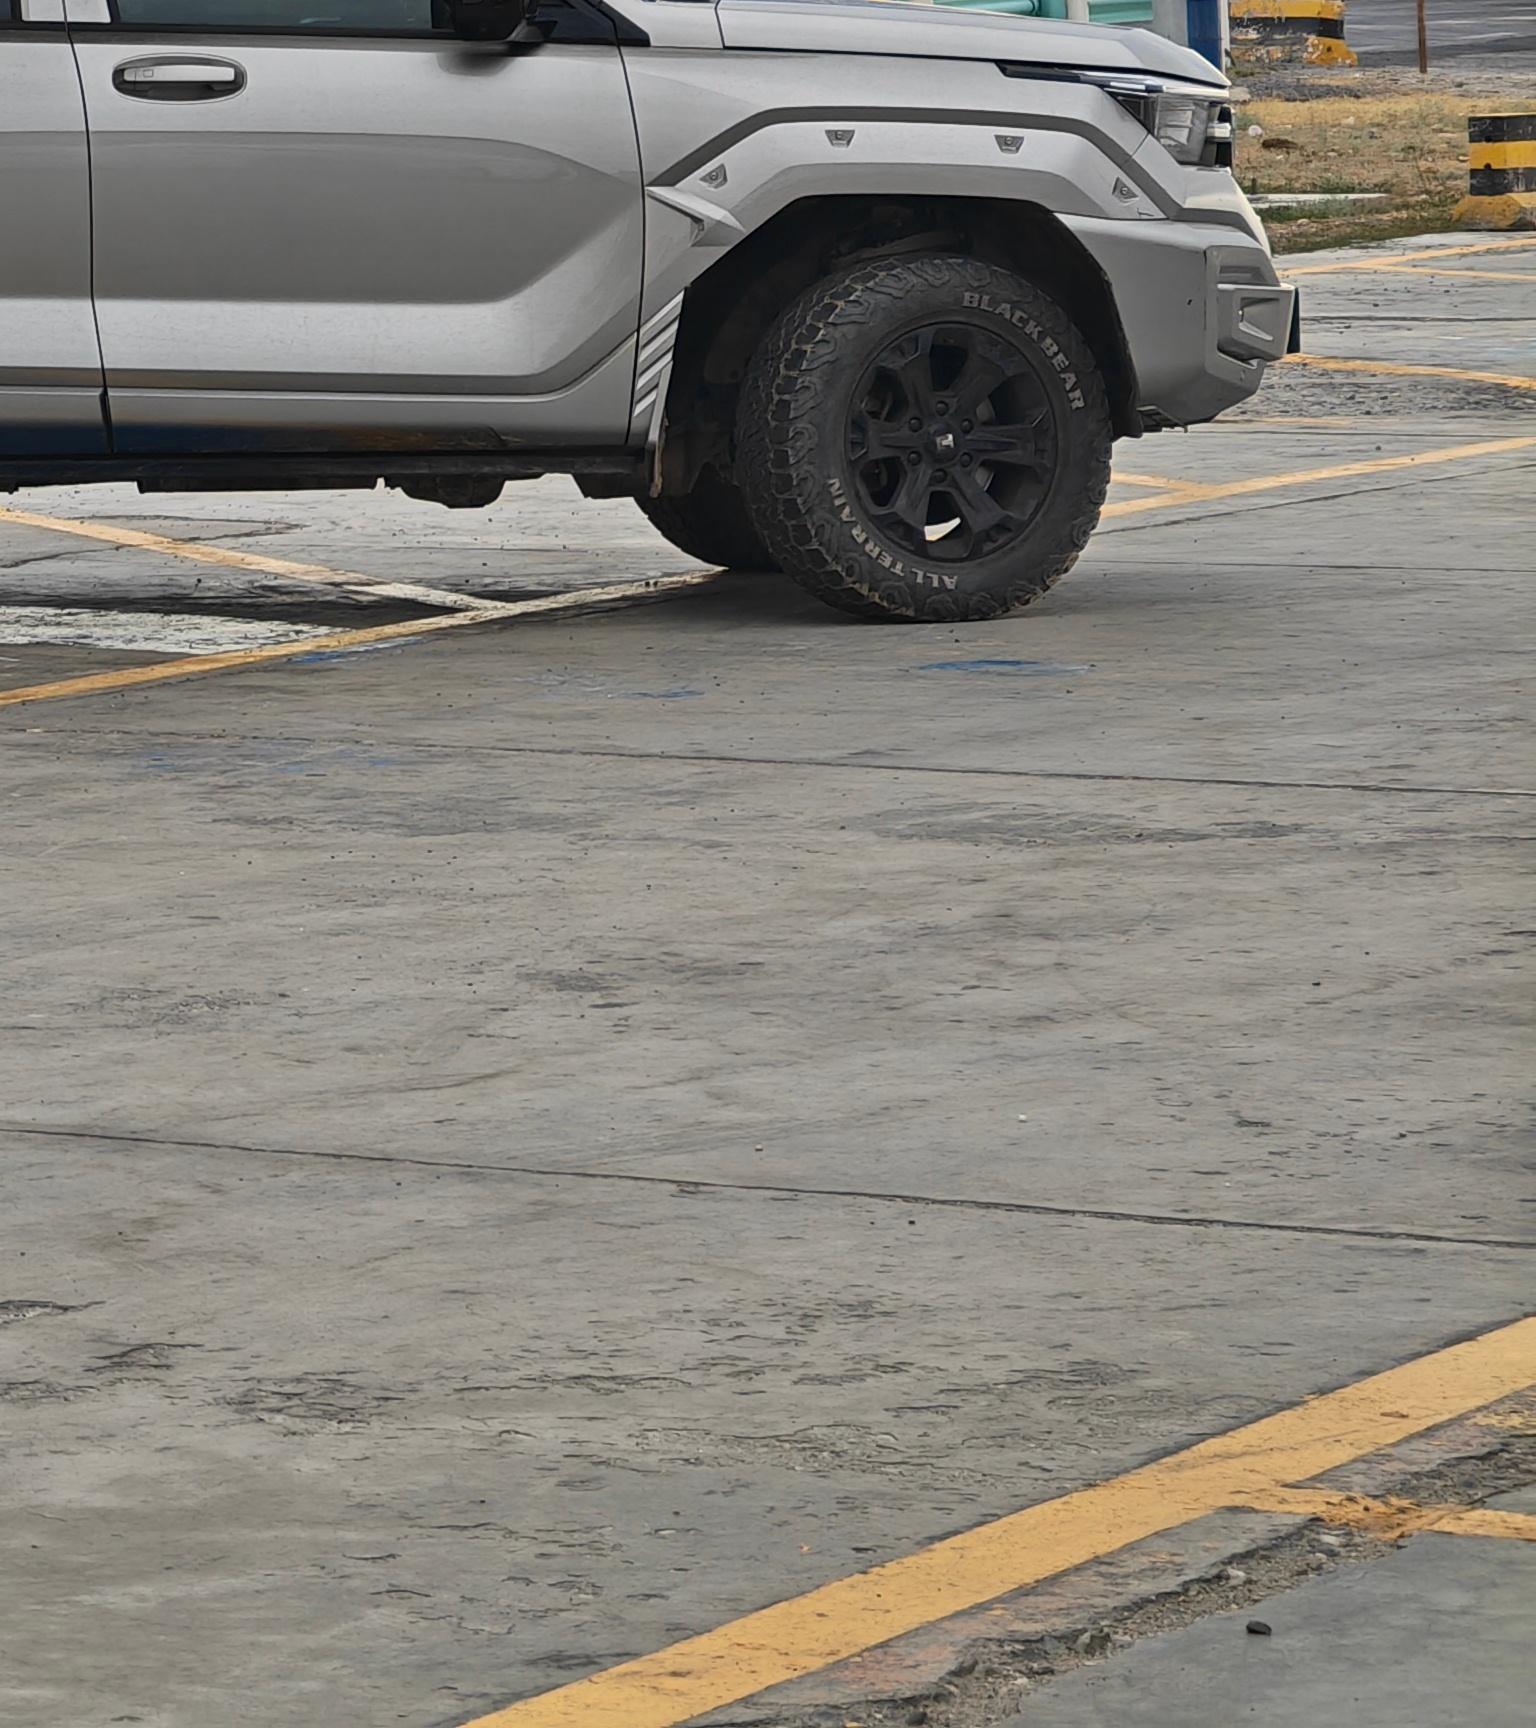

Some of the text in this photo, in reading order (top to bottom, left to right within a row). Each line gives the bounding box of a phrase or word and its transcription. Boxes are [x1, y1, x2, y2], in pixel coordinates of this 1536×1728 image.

[962, 290, 1086, 411] BLACK BEAR
[829, 478, 957, 590] ALL TERRAIN
